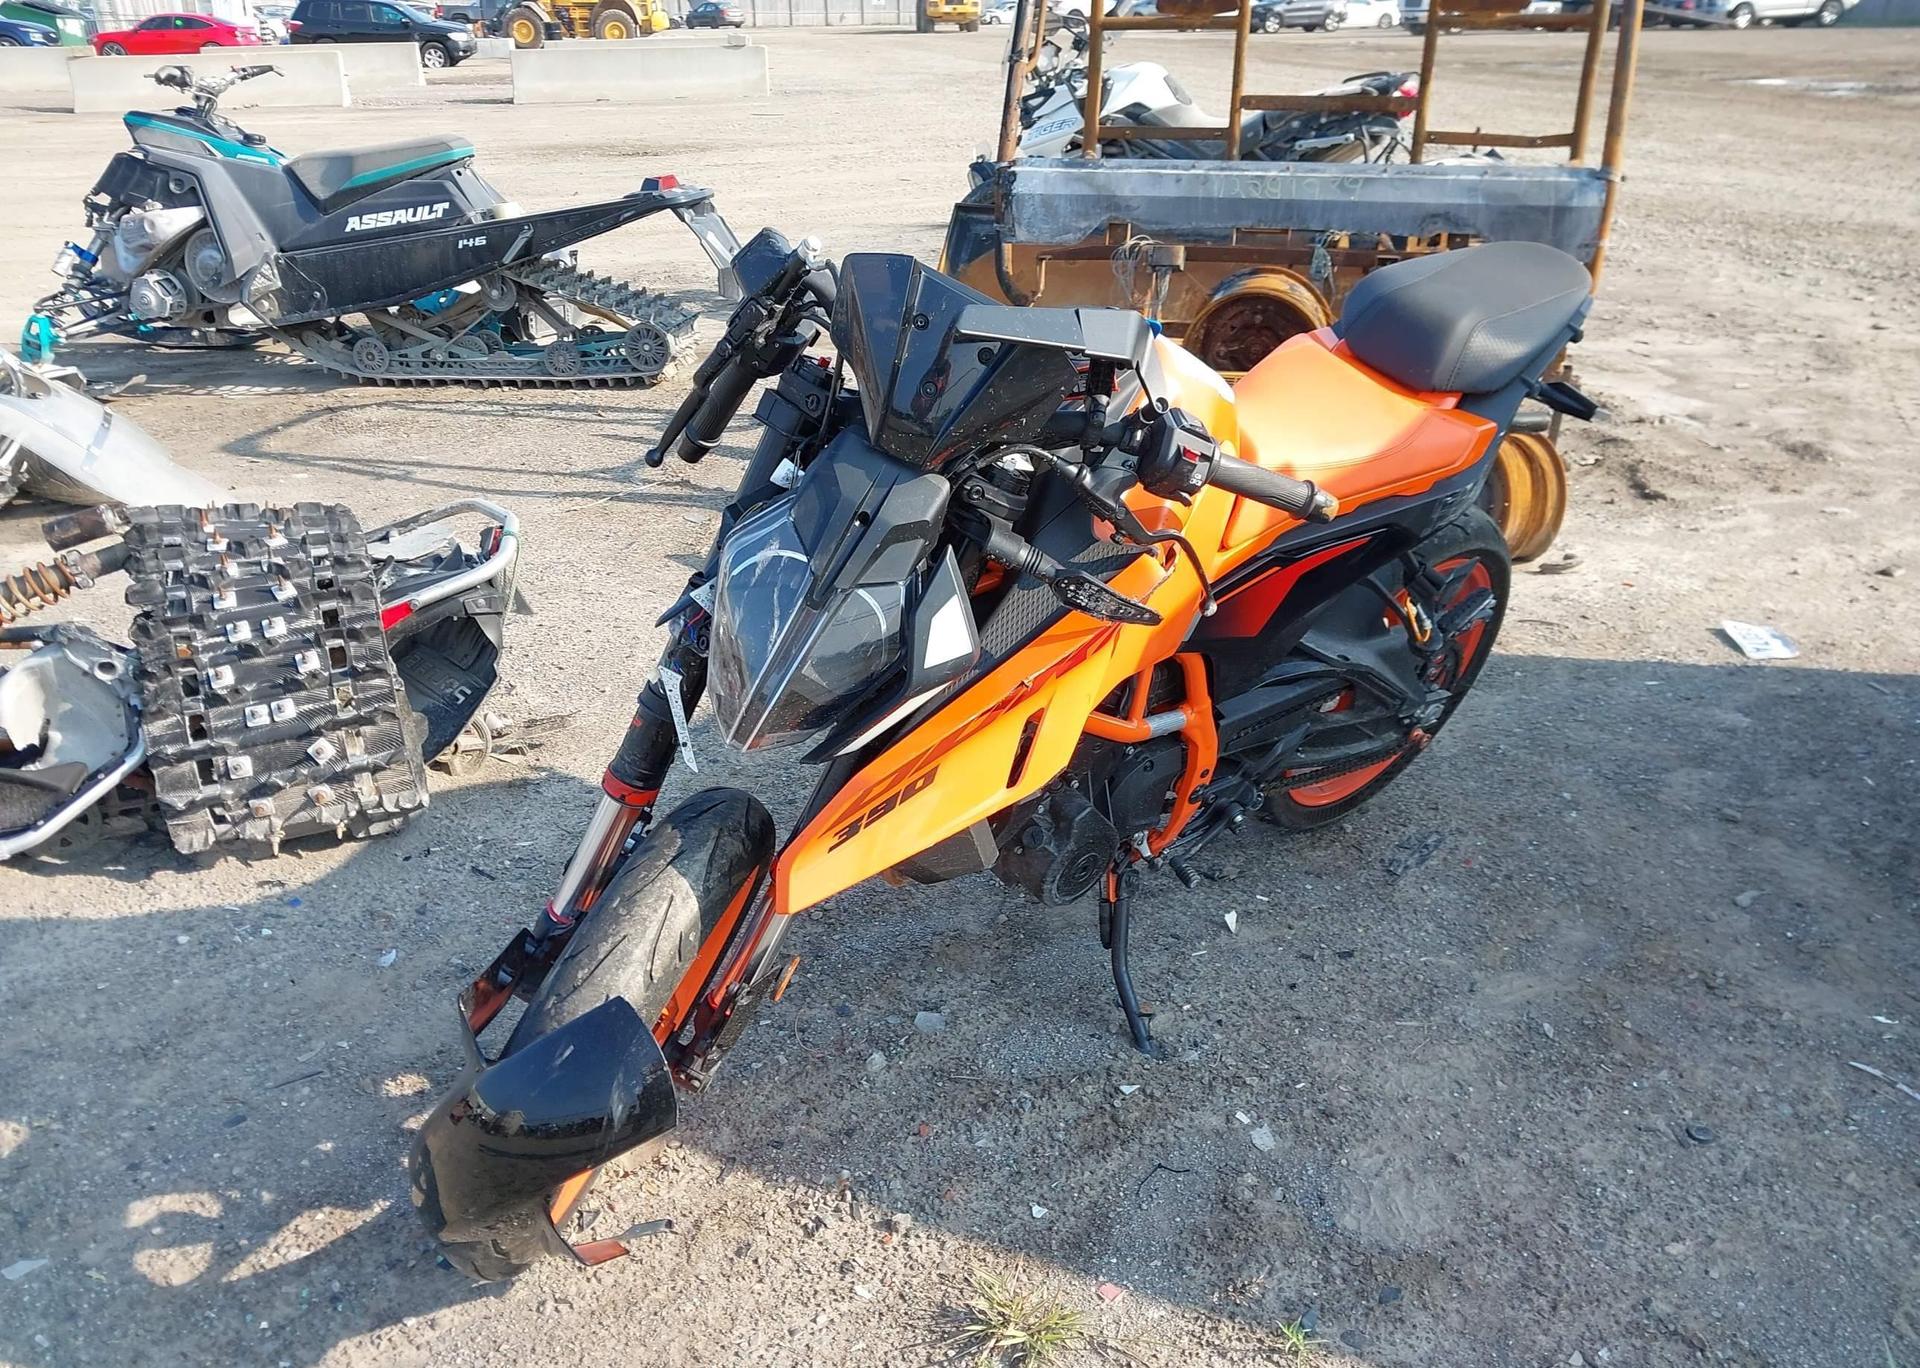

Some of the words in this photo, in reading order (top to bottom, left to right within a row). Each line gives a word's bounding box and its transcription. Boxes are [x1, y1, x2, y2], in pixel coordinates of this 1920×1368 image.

[344, 201, 450, 232] ASSAULT
[458, 236, 487, 249] 146
[827, 764, 941, 854] 390
